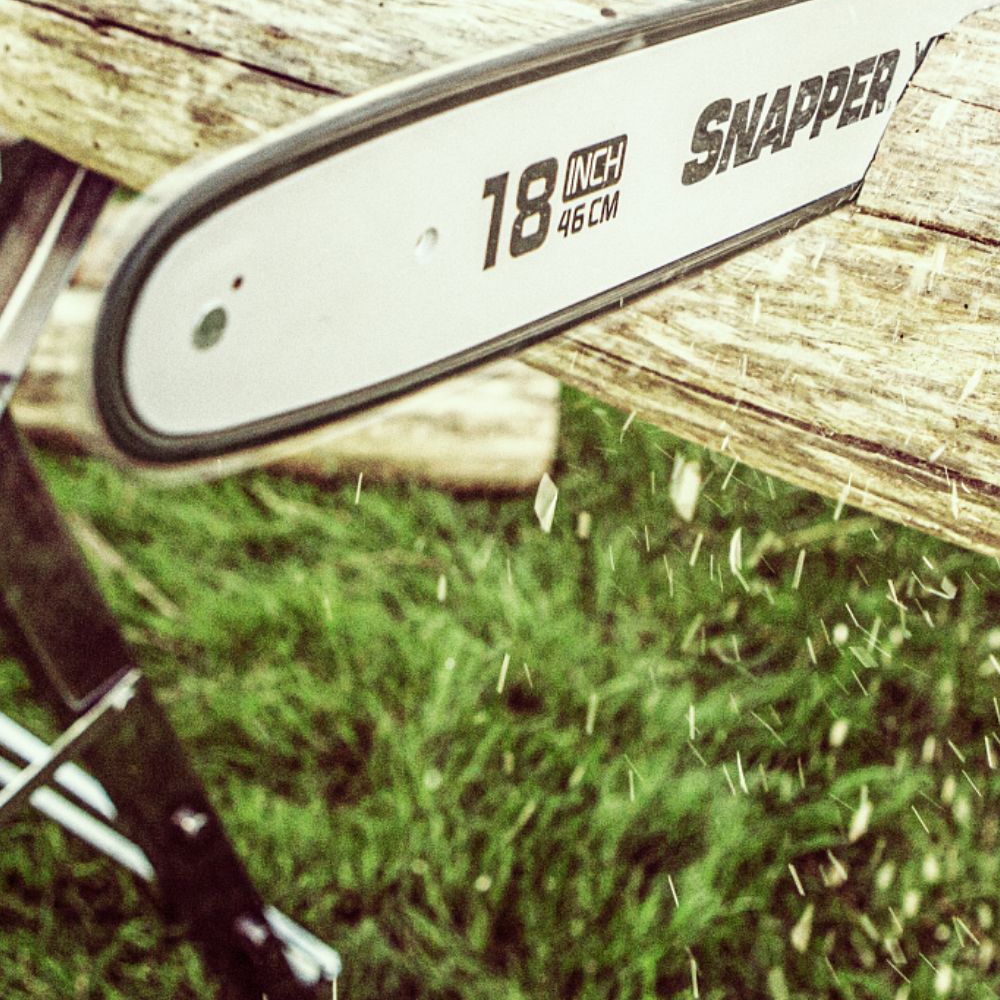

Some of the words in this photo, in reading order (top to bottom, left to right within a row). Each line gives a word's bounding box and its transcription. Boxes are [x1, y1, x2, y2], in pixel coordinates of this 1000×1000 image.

[681, 48, 900, 186] SNAPPER
[482, 157, 559, 271] 18
[565, 141, 624, 197] INCH
